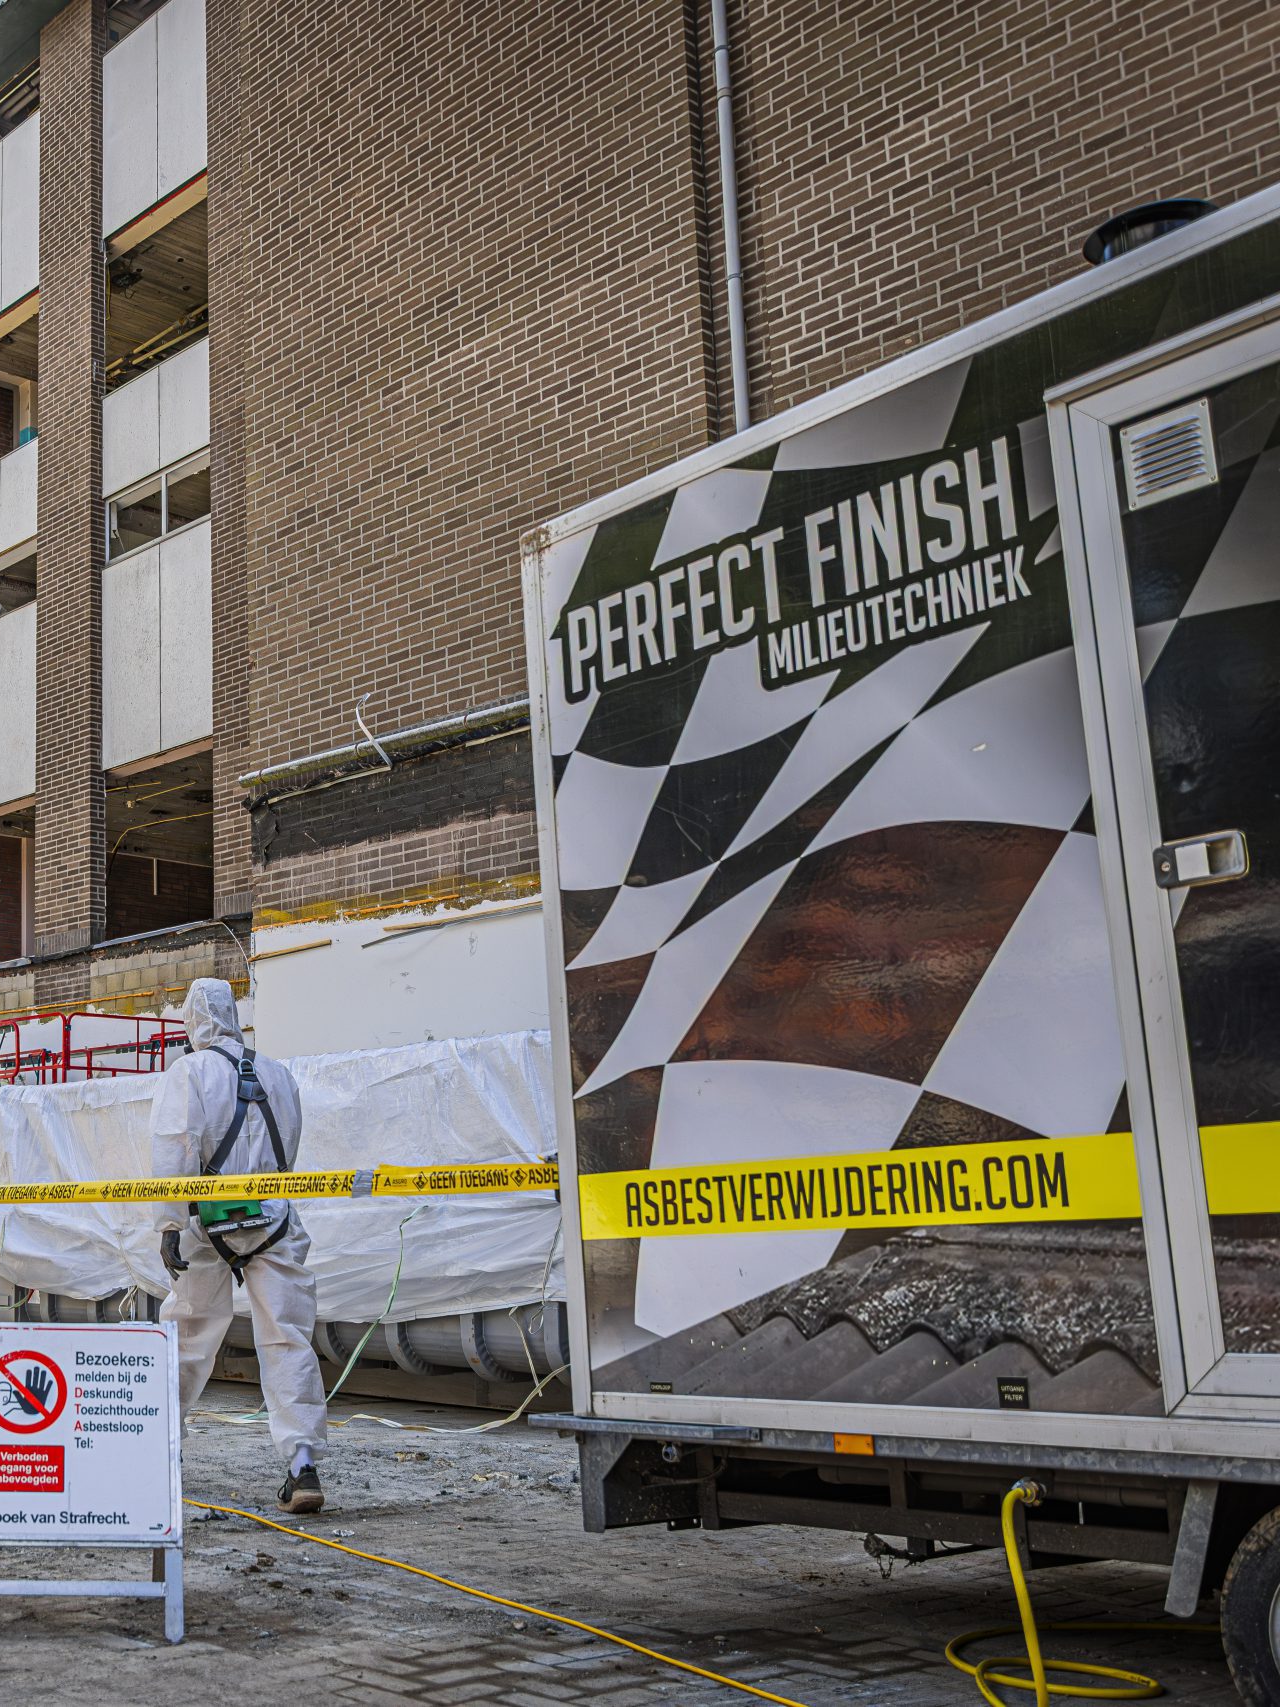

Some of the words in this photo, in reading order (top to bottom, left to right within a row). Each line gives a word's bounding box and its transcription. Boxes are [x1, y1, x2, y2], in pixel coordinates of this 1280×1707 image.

[566, 526, 784, 694] PERFECT
[804, 435, 1018, 608] FINISH
[767, 545, 1032, 680] MILIEUTECHNIEK
[257, 1177, 281, 1195] GEEN
[282, 1175, 327, 1194] TOEGANG
[430, 1171, 456, 1190] GEEN
[459, 1170, 509, 1188] TOEGANG
[6, 1185, 40, 1200] TOEGANG
[48, 1184, 79, 1199] ASBEST
[111, 1182, 134, 1198] GEEN
[133, 1181, 172, 1197] TOEGANG
[182, 1179, 217, 1196] ASBEST
[624, 1151, 1070, 1228] ASBESTVERWIJDERING.COM
[75, 1351, 155, 1367] Bezoekers:
[75, 1371, 115, 1382] melden
[118, 1371, 131, 1386] bij
[134, 1372, 147, 1383] de
[74, 1387, 133, 1402] Deskundig
[1004, 1393, 1023, 1401] FILTER
[74, 1403, 160, 1416] Toezichthouder
[74, 1420, 144, 1435] Asbestsloop
[74, 1437, 94, 1449] Tel:
[0, 1452, 49, 1462] Verboden
[34, 1465, 59, 1473] voor
[30, 1513, 56, 1524] van
[59, 1511, 130, 1525] Strafrecht.
